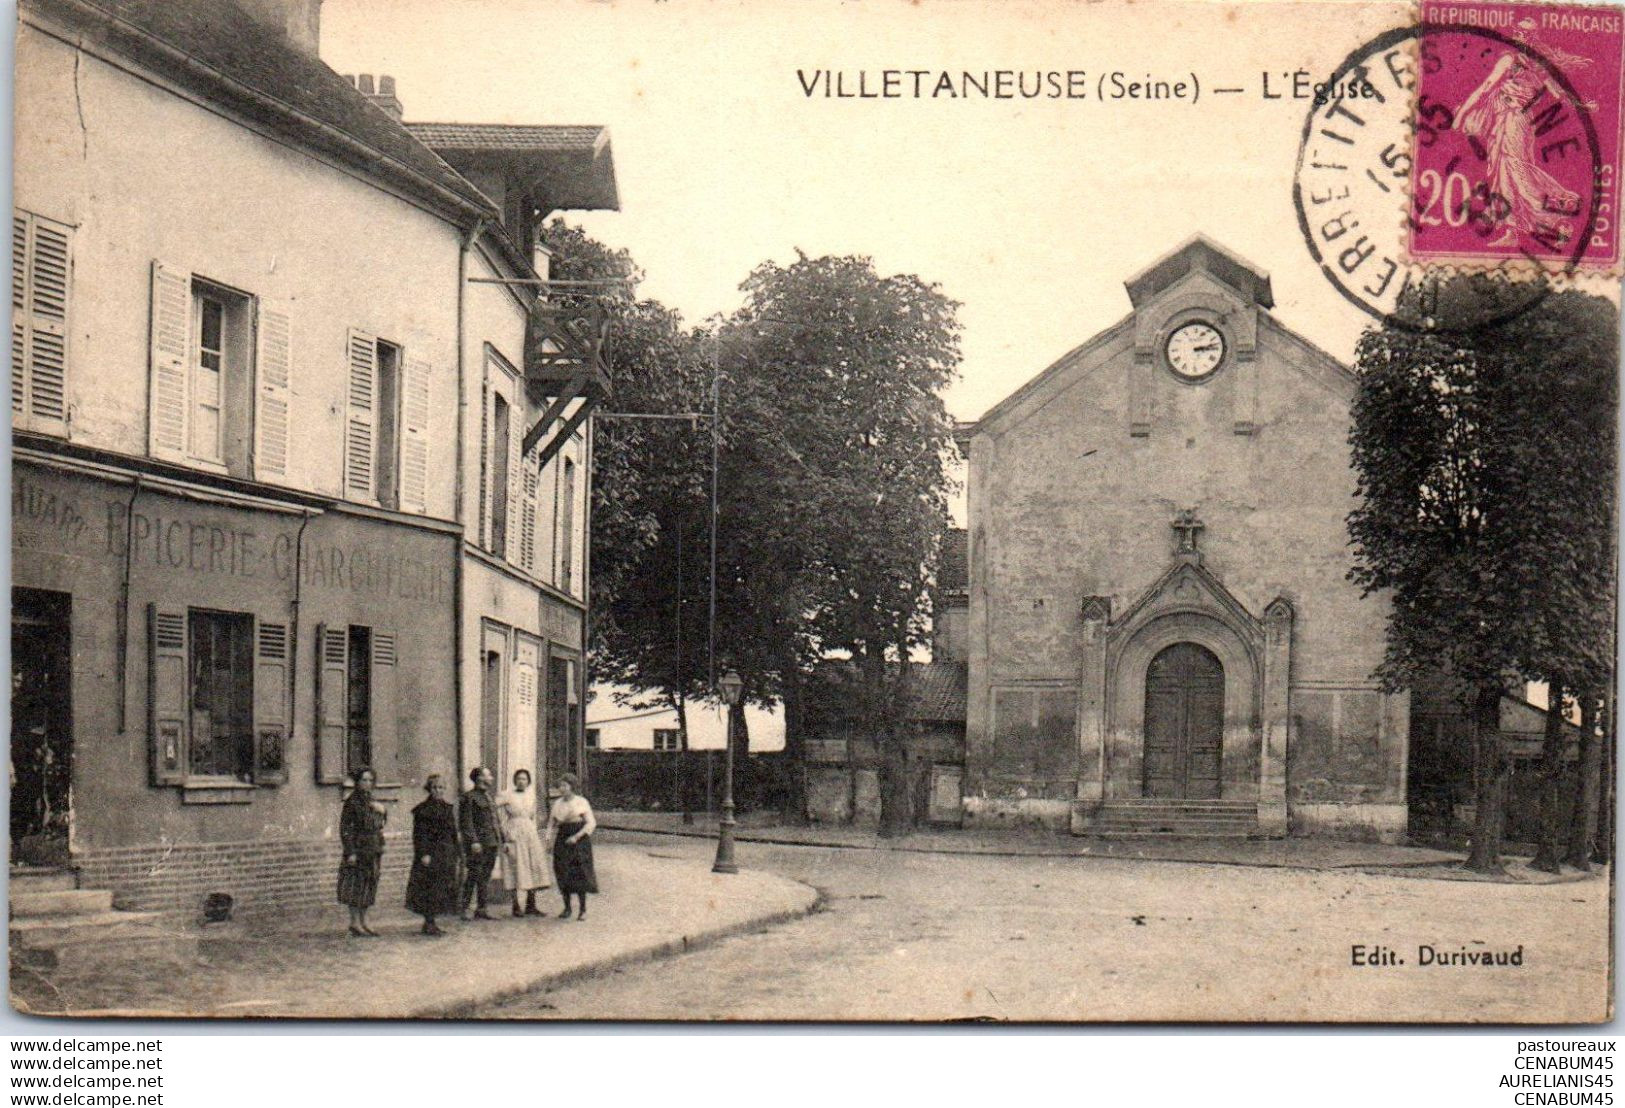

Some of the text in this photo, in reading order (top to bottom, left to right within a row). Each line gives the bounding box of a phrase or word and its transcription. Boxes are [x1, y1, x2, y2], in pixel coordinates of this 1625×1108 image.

[1542, 12, 1620, 34] FRANÇAISE
[1419, 168, 1470, 227] 20
[1591, 163, 1615, 249] POSTES
